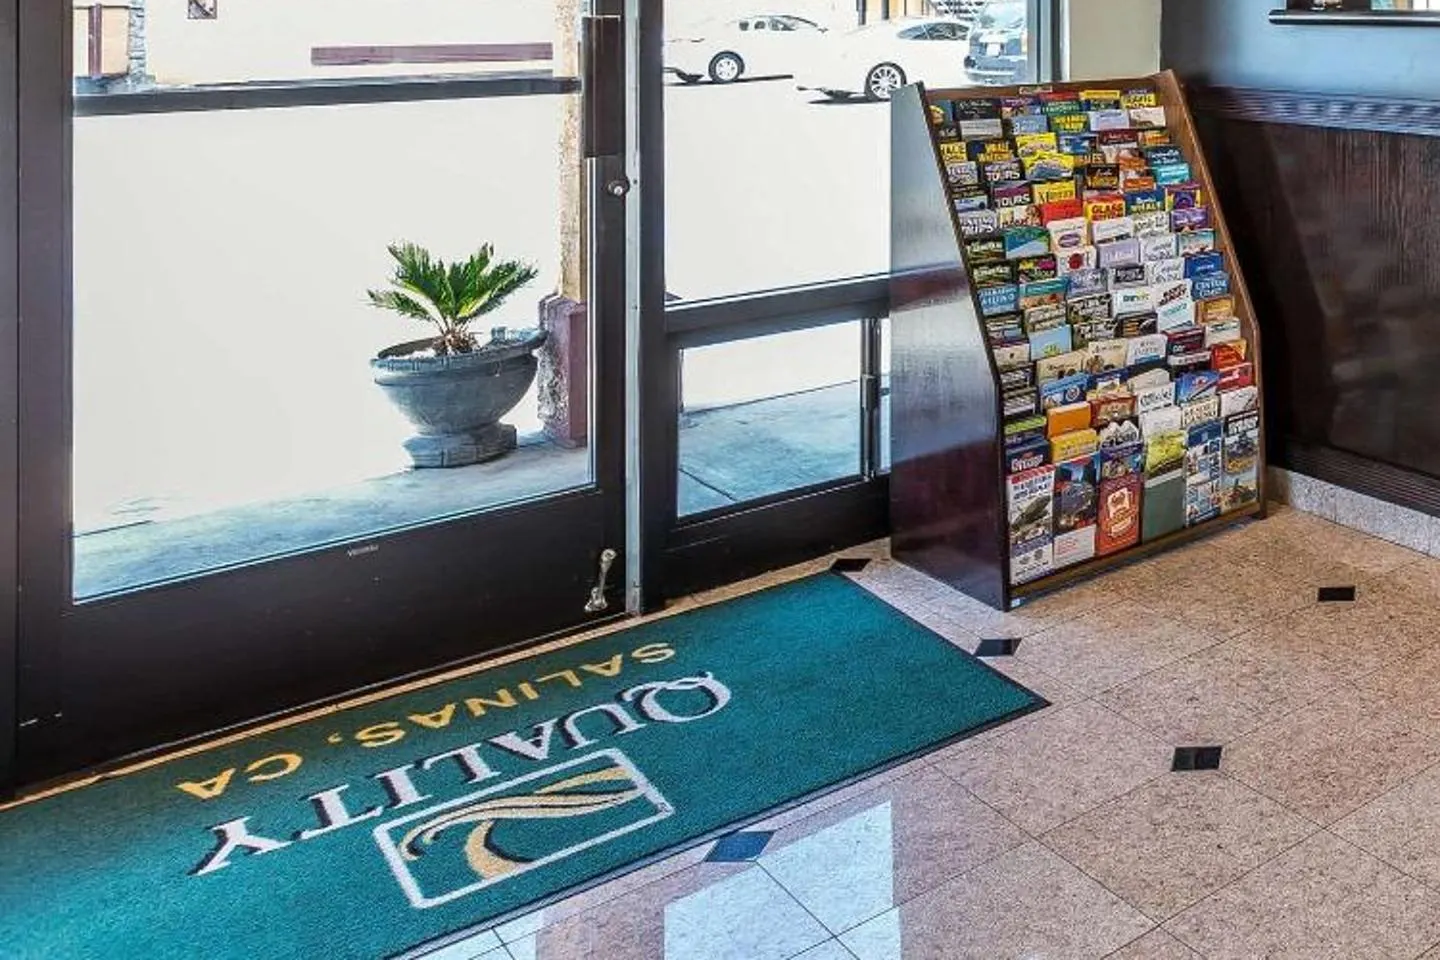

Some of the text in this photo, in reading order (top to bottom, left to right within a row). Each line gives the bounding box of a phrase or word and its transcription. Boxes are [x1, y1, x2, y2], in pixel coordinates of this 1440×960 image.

[175, 642, 677, 801] SALINAS, CA
[187, 670, 733, 876] QUALITY
